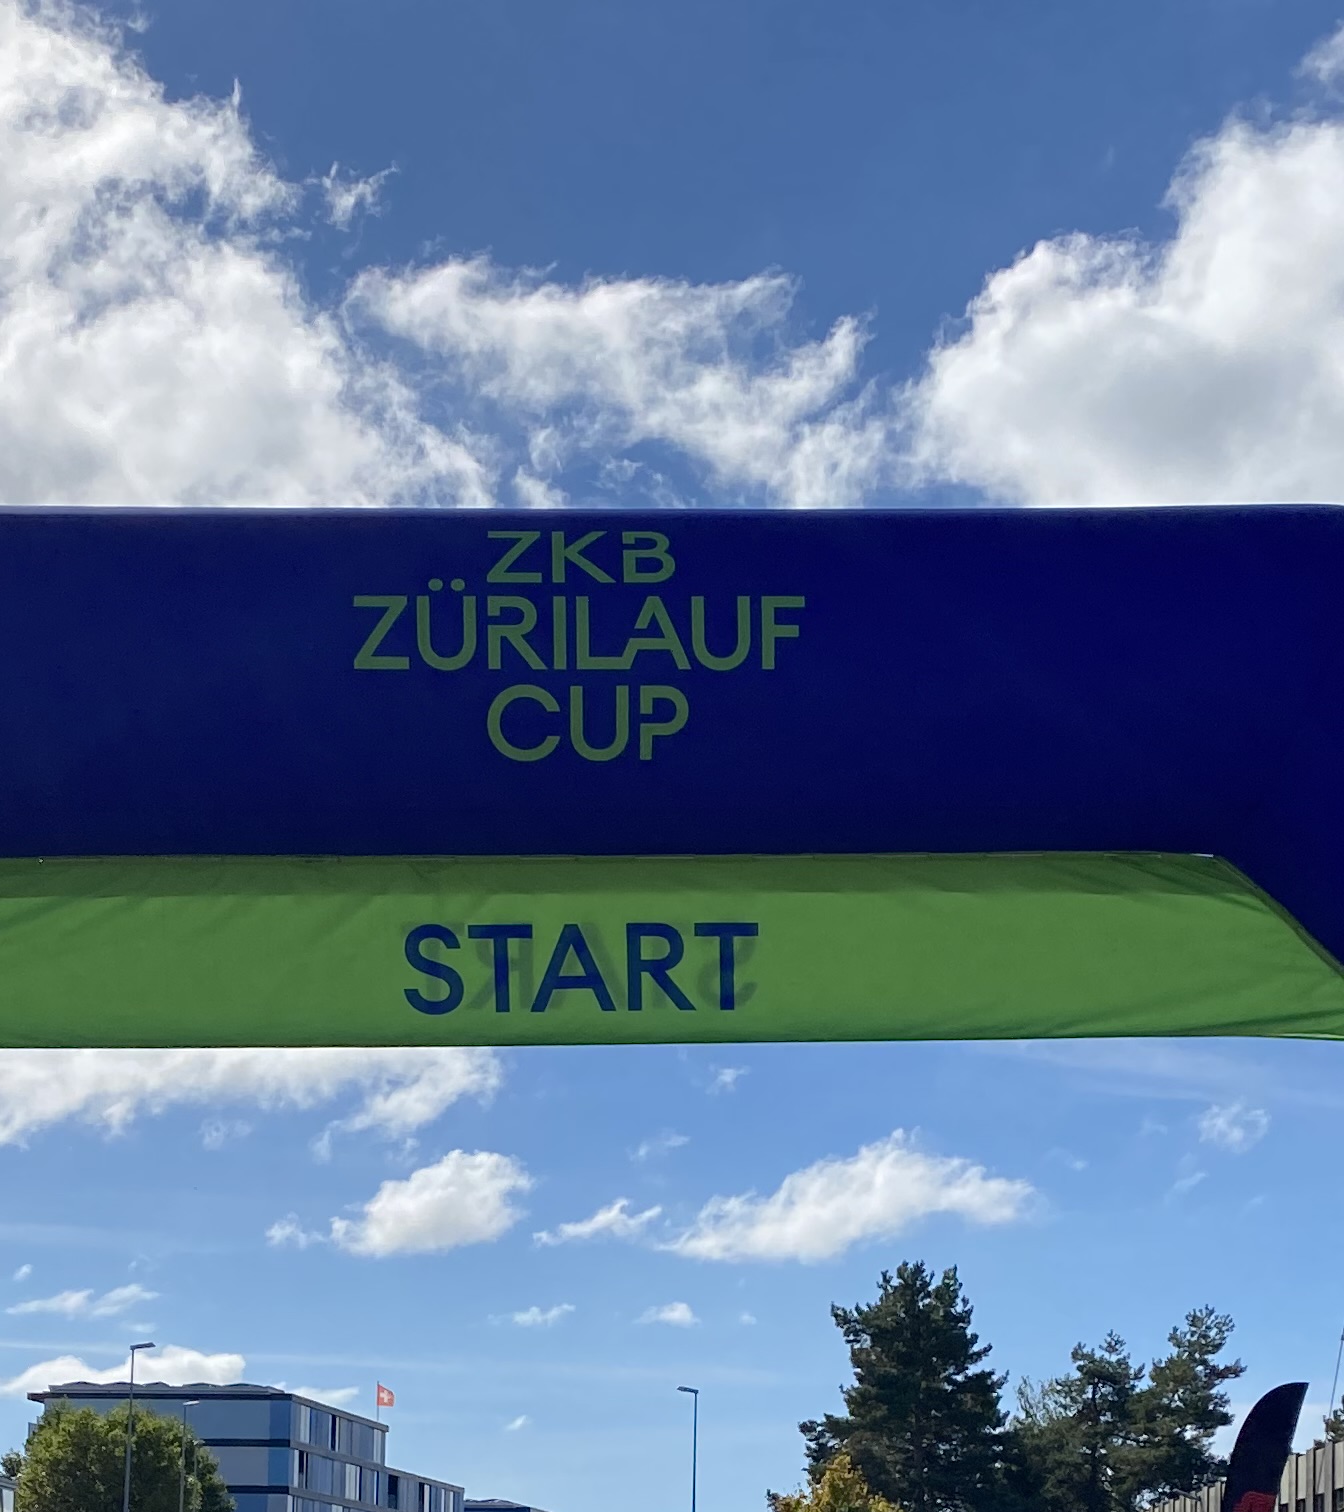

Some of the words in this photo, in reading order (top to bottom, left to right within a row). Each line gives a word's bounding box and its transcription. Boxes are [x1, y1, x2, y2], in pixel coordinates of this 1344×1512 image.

[487, 531, 675, 583] ZKB
[353, 578, 805, 671] ZÜRILAUF
[487, 684, 689, 761] CUP
[403, 922, 759, 1015] START
